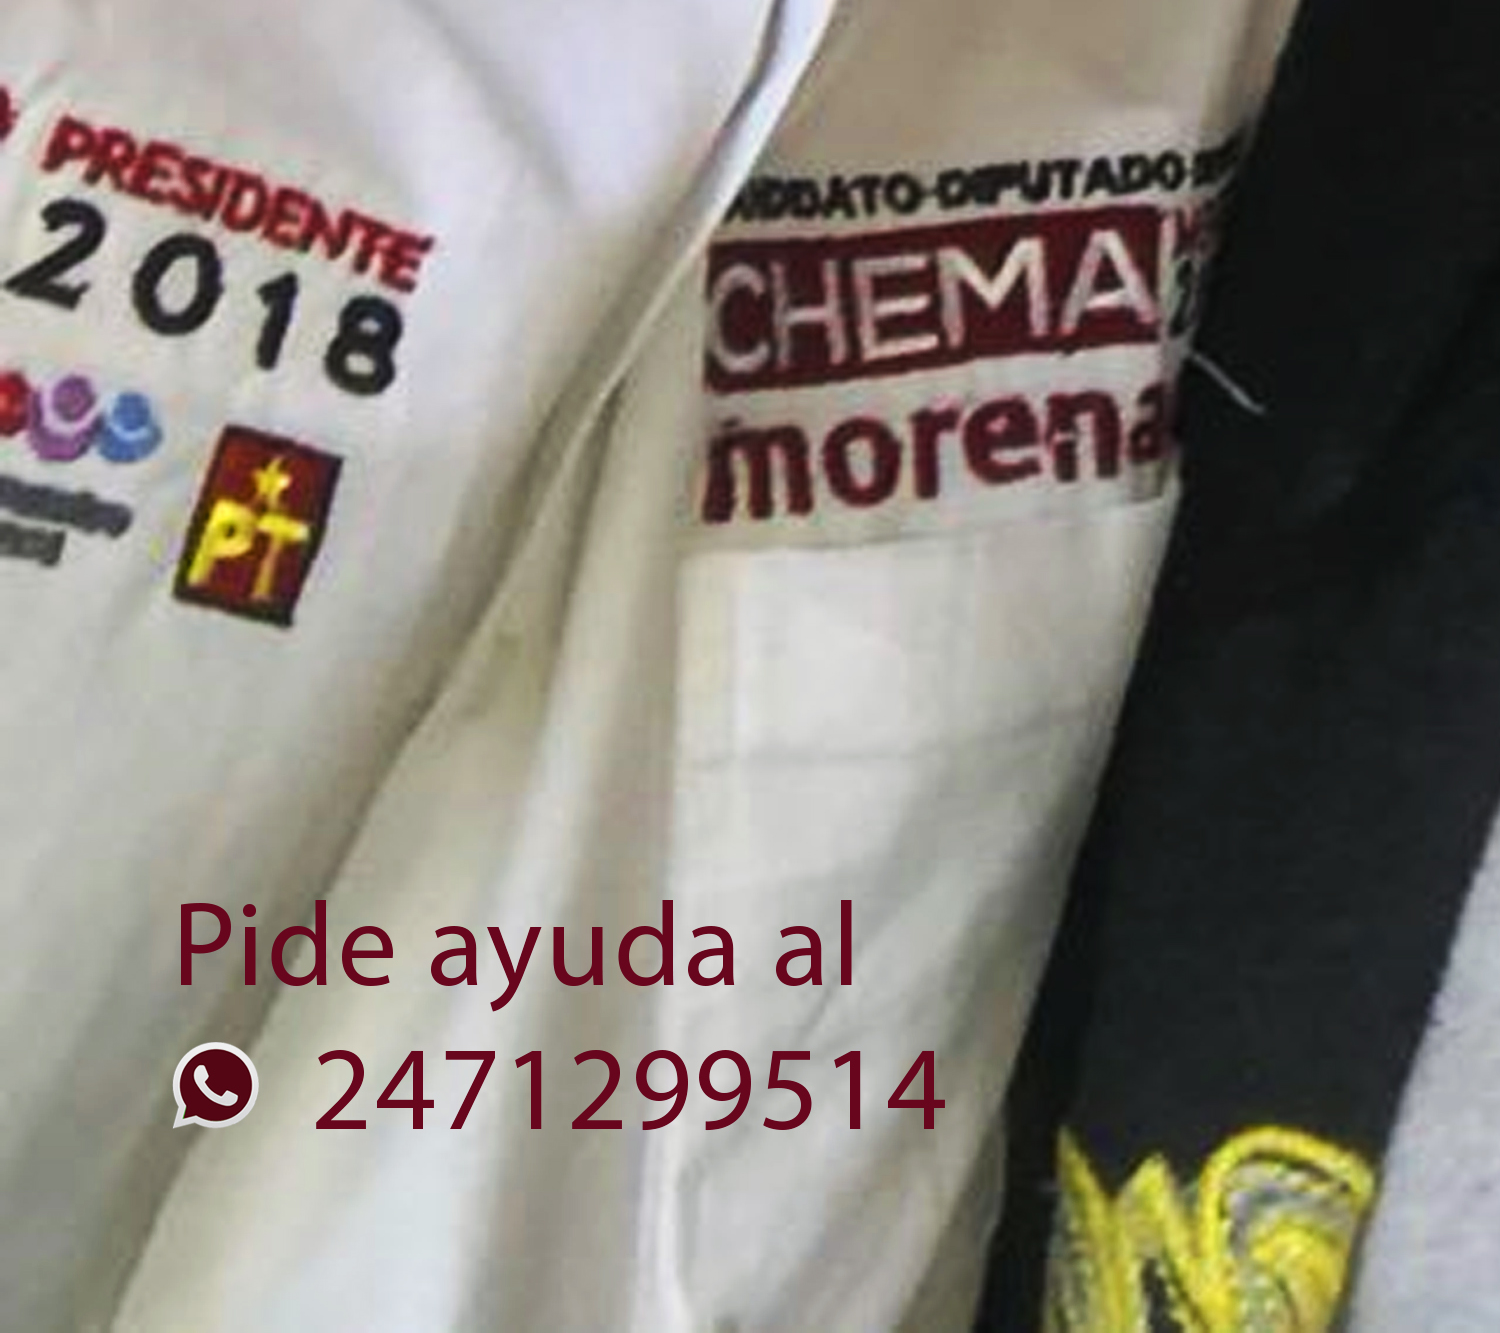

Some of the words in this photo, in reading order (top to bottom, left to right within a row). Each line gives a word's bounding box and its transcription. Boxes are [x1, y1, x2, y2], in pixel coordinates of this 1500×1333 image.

[40, 115, 435, 293] PRESIDENTE
[3, 197, 404, 396] 2018
[708, 229, 1160, 375] CHEMA
[702, 383, 1170, 525] morena
[187, 498, 310, 600] PT
